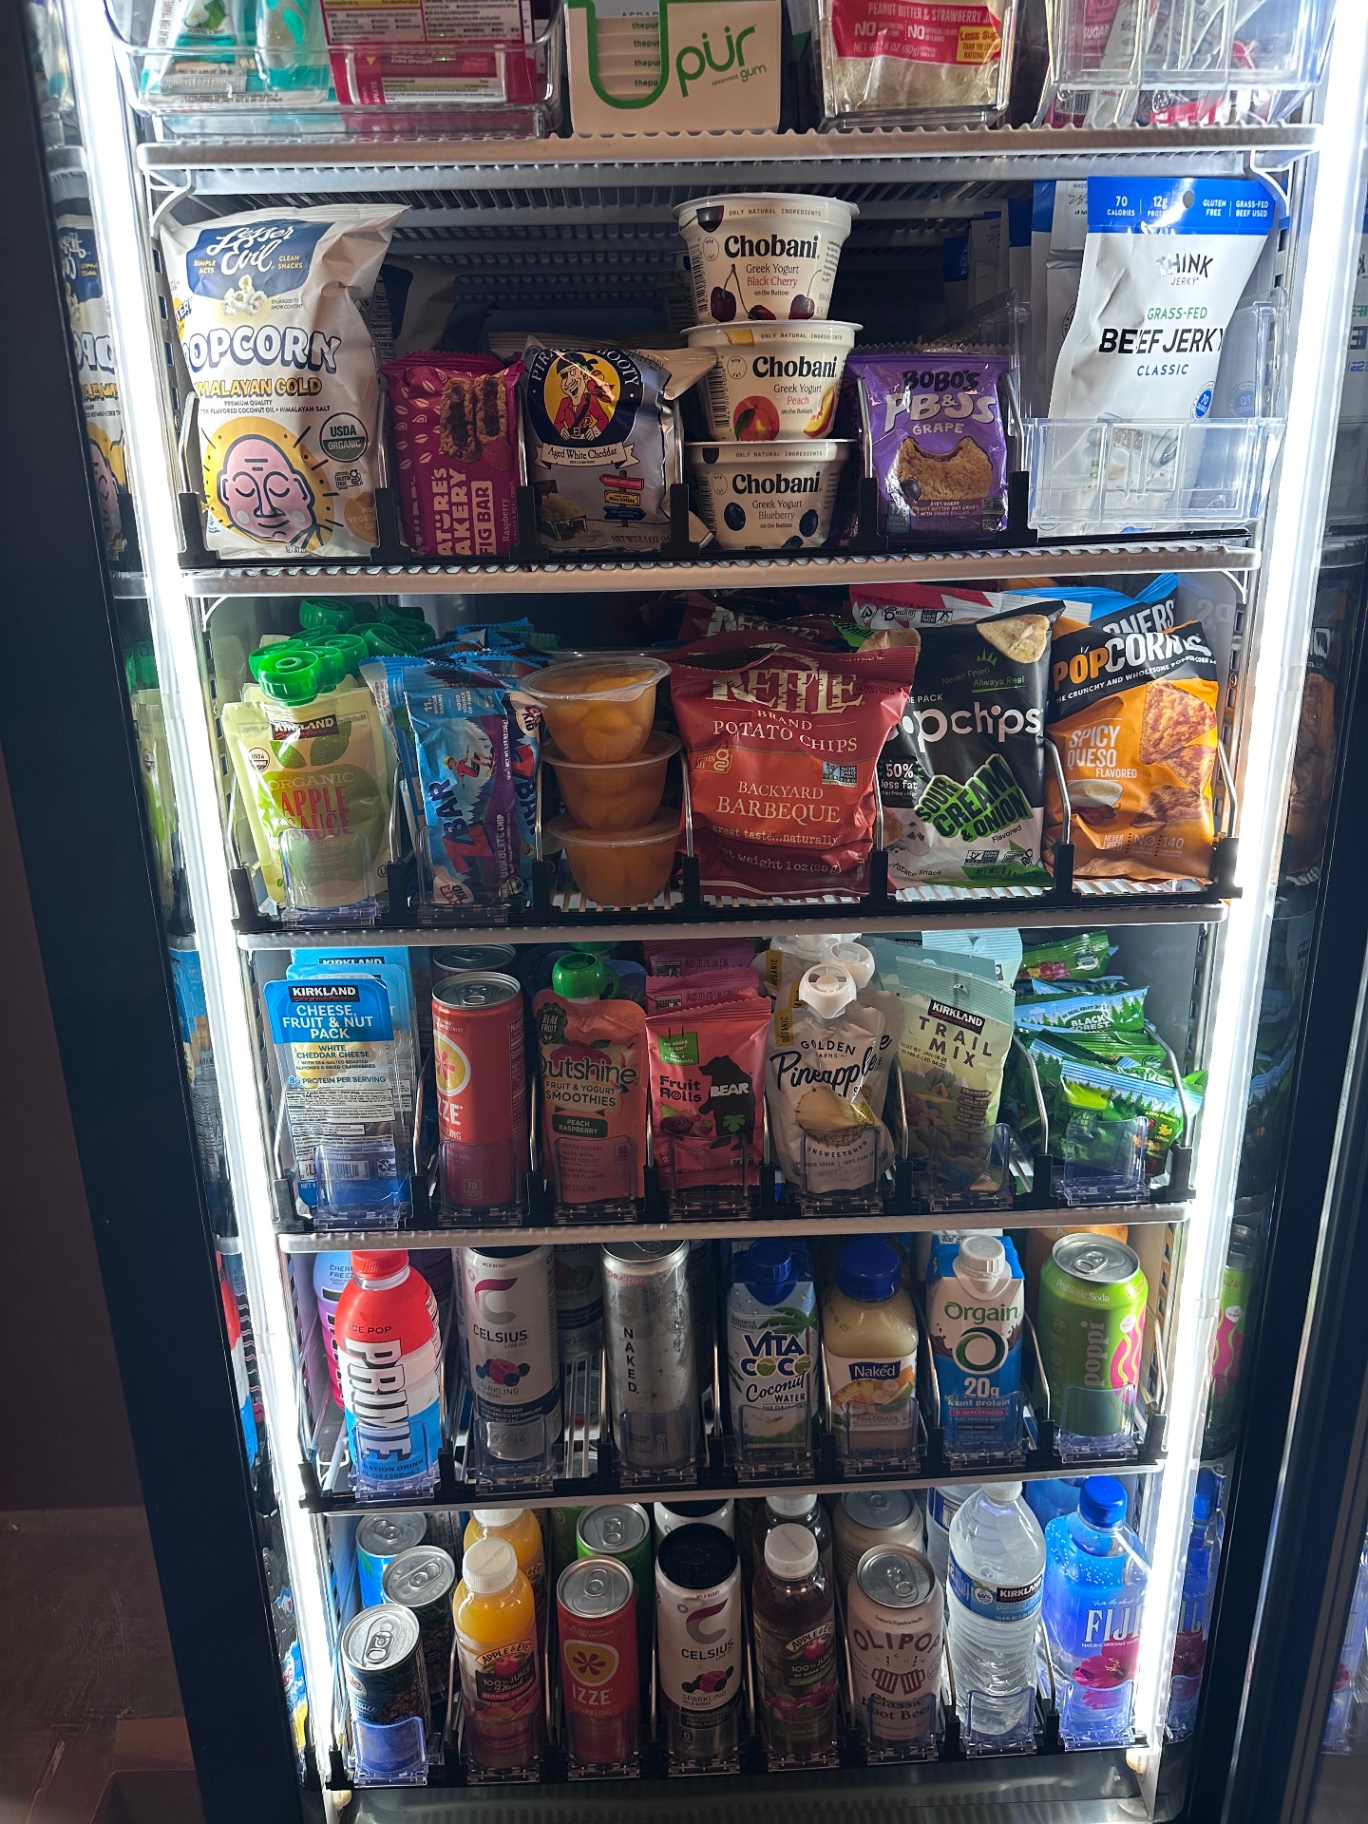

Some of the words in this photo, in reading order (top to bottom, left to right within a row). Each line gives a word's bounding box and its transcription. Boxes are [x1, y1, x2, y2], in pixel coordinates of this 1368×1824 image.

[868, 3, 896, 16] PEANUT
[932, 10, 981, 23] STRAWBERRY
[854, 21, 877, 37] NO
[907, 24, 925, 39] NO
[960, 31, 979, 41] Less
[675, 24, 757, 98] pür
[740, 64, 767, 82] gum
[1115, 196, 1128, 206] 70
[1152, 195, 1168, 210] 12g
[1203, 199, 1227, 207] GLUTEN
[1235, 200, 1269, 209] GRASS-FED
[748, 208, 777, 216] NATURAL
[781, 208, 822, 217] INGREDIENTS
[1252, 209, 1268, 217] USED
[206, 226, 295, 256] Lesser
[724, 234, 819, 259] Chobani
[220, 238, 284, 276] Evil
[1155, 253, 1215, 277] THINK
[277, 262, 303, 270] SNACKS
[745, 263, 771, 274] Greek
[772, 263, 800, 275] Yogurt
[747, 276, 769, 286] Black
[771, 276, 798, 288] Cherry
[1170, 277, 1198, 286] JERKY
[1147, 307, 1208, 320] GRASS-FED
[1099, 328, 1160, 354] BEEF
[1162, 328, 1226, 353] JERKY
[752, 356, 837, 379] Chobani
[1136, 364, 1189, 377] CLASSIC
[275, 377, 323, 398] GOLD
[903, 369, 982, 391] BOBO'S
[773, 384, 797, 393] Greek
[799, 384, 822, 394] Yogurt
[786, 396, 809, 405] Peach
[329, 426, 357, 437] USDA
[912, 423, 965, 436] GRAPE
[327, 440, 362, 450] ORGANIC
[548, 448, 565, 459] Aged
[565, 449, 587, 460] White
[588, 448, 618, 459] Cheddar
[731, 471, 822, 494] Chobani
[475, 487, 491, 523] BAR
[752, 500, 776, 508] Greek
[777, 500, 803, 510] Yogurt
[501, 498, 510, 542] Raspberry
[758, 511, 795, 521] Blueberry
[941, 674, 966, 685] Never
[967, 666, 990, 679] Fried
[973, 677, 1003, 688] Always
[1006, 675, 1025, 684] Real
[1068, 682, 1105, 701] CRUNCHY
[1106, 676, 1123, 687] AND
[1125, 664, 1170, 681] WHOLESOME
[705, 655, 864, 714] KETTLE
[917, 693, 944, 704] PACK
[274, 717, 335, 732] KIRKLAND
[757, 710, 813, 731] BRAND
[713, 721, 793, 741] POTATO
[799, 733, 858, 752] CHIPS
[1068, 725, 1121, 748] SPICY
[1067, 749, 1117, 770] QUESO
[885, 763, 914, 778] 50%
[1096, 768, 1138, 779] FLAVORED
[268, 772, 355, 791] ORGANIC
[880, 781, 900, 790] less
[902, 780, 918, 790] fat
[737, 781, 824, 800] BACKYARD
[932, 758, 1016, 838] CREAM
[281, 786, 350, 817] APPLE
[915, 778, 960, 822] SOUR
[716, 796, 841, 825] BARBEQUE
[960, 829, 973, 841] &
[972, 788, 1030, 838] ONION
[288, 810, 355, 841] SAUCE
[991, 825, 1022, 843] Flavored
[1162, 836, 1184, 849] 140
[737, 854, 783, 870] weight
[919, 868, 942, 876] snack
[292, 986, 357, 996] KIRKLAND
[283, 1016, 324, 1028] FRUIT
[329, 1016, 340, 1027] &
[344, 1016, 374, 1028] NUT
[542, 1015, 558, 1024] REAL
[932, 1002, 983, 1027] KIRKLAND
[1070, 1014, 1104, 1027] BLACK
[310, 1028, 350, 1039] PACK
[541, 1024, 557, 1034] FRUIT
[918, 1015, 992, 1057] TRAIL
[296, 1051, 336, 1059] CHEDDAR
[800, 1039, 855, 1056] GOLDEN
[928, 1038, 976, 1068] MIX
[769, 1045, 877, 1097] Pineapple
[289, 1076, 300, 1085] 8g
[302, 1076, 336, 1084] PROTEIN
[546, 1081, 570, 1090] FRUIT
[580, 1084, 615, 1095] YOGURT
[660, 1075, 701, 1092] Fruit
[660, 1088, 702, 1102] Rolls
[710, 1082, 750, 1097] BEAR
[545, 1091, 616, 1107] SMOOTHIES
[558, 1125, 598, 1135] RASPBERRY
[566, 1119, 590, 1127] PEACH
[807, 1141, 867, 1158] UNSWEETENED
[1088, 1292, 1110, 1303] Soda
[943, 1301, 1019, 1325] Orgain
[367, 1325, 392, 1334] POP
[473, 1324, 528, 1343] CELSIUS
[742, 1330, 807, 1356] VITA
[1081, 1319, 1110, 1387] poppi
[740, 1355, 812, 1377] COCO
[854, 1364, 895, 1377] Naked
[746, 1374, 806, 1402] Coconut
[963, 1377, 1000, 1398] 20g
[344, 1338, 412, 1461] PRIME
[774, 1393, 806, 1402] WATER
[396, 1458, 424, 1471] DRINK
[1084, 1608, 1144, 1642] FIJI
[681, 1638, 734, 1660] CELSIUS
[791, 1631, 817, 1652] APPLE
[853, 1629, 941, 1653] OLIPOP
[482, 1648, 510, 1664] APPLE
[510, 1666, 531, 1683] JUICE
[572, 1685, 611, 1705] IZZE
[682, 1690, 727, 1702] SPARKLING
[870, 1692, 926, 1709] Classic
[899, 1704, 931, 1720] Beer
